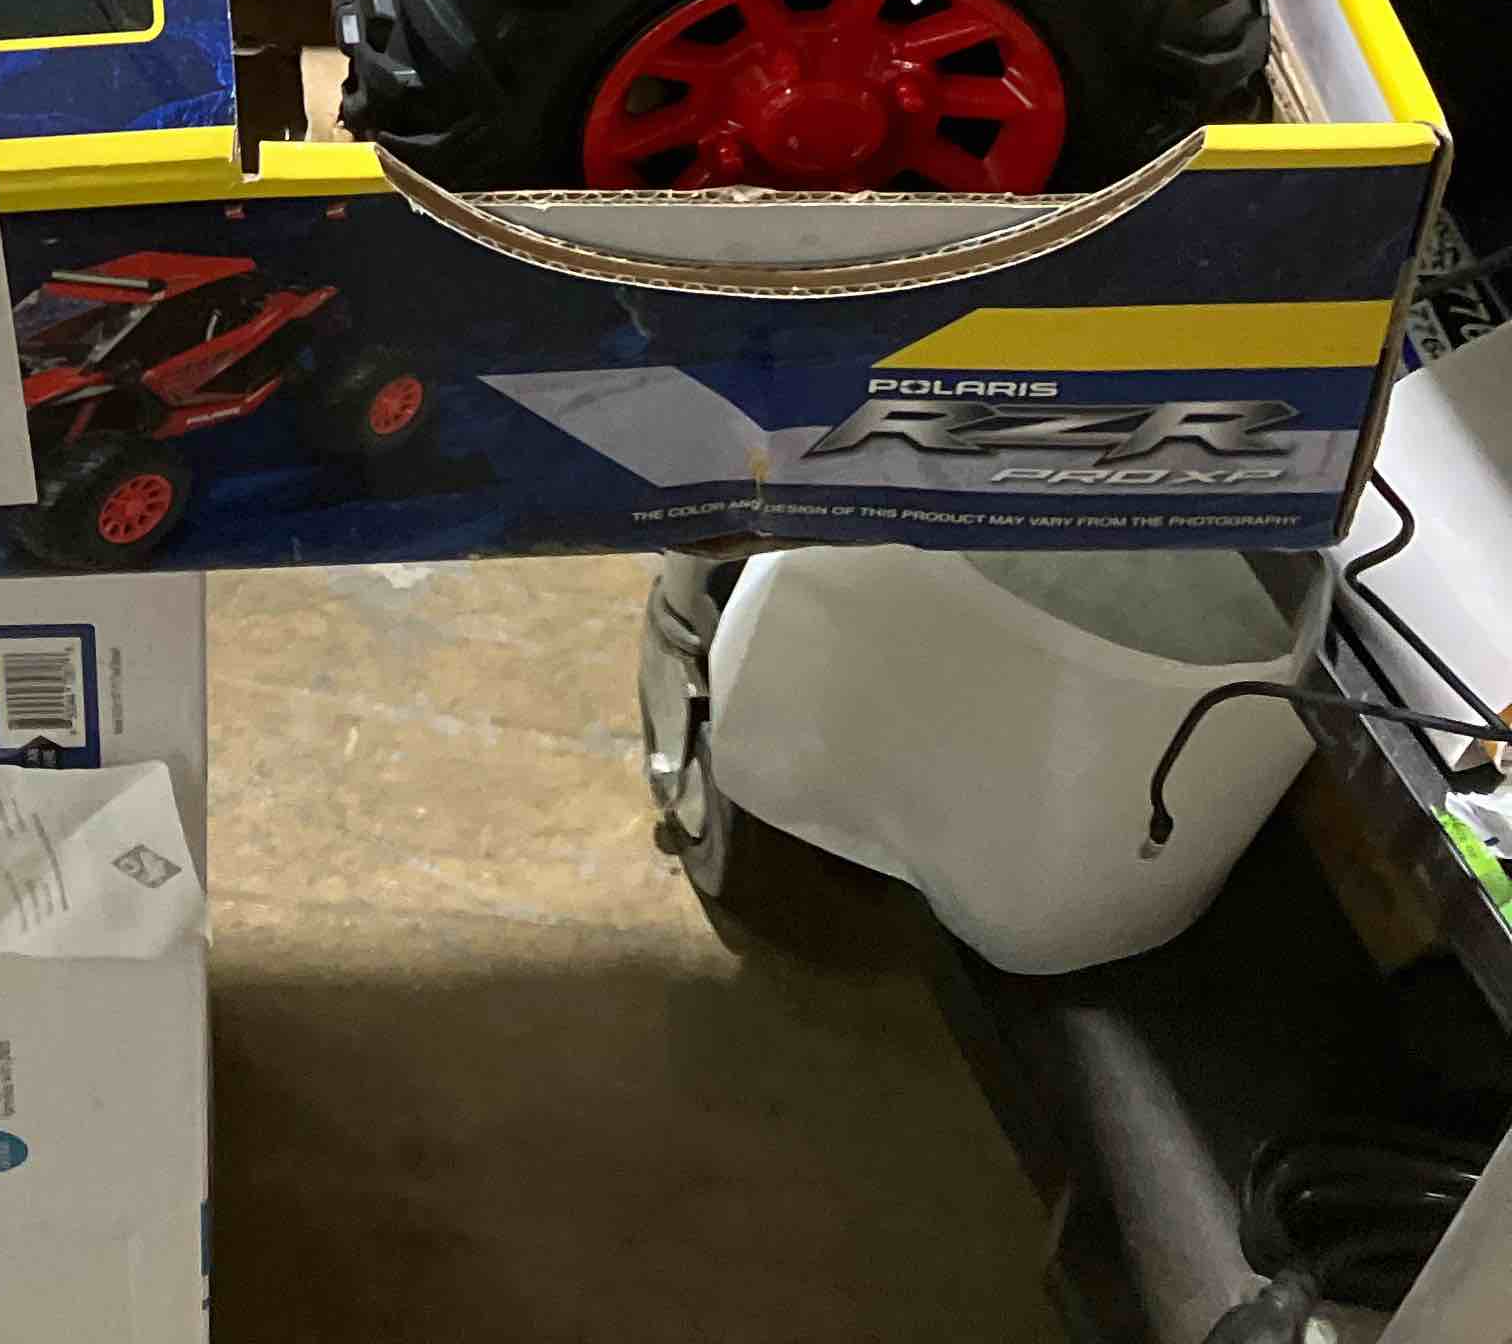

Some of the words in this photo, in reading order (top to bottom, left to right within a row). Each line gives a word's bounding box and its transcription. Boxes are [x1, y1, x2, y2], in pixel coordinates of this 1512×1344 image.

[867, 378, 1059, 397] POLARIS
[799, 398, 1301, 467] RZR
[991, 467, 1170, 484] PRO
[1173, 468, 1286, 484] XP
[631, 511, 664, 522] THE
[667, 501, 726, 518] COLOR
[727, 496, 764, 511] AND
[763, 503, 828, 515] DESIGN
[831, 505, 857, 516] OF
[859, 506, 898, 518] THIS
[900, 509, 988, 525] PRODUCT
[988, 514, 1025, 526] MAY
[1028, 515, 1074, 527] VARY
[1076, 515, 1128, 528] FROM
[1131, 515, 1164, 527] THE
[1168, 514, 1301, 528] PHOTOGRAPHY
